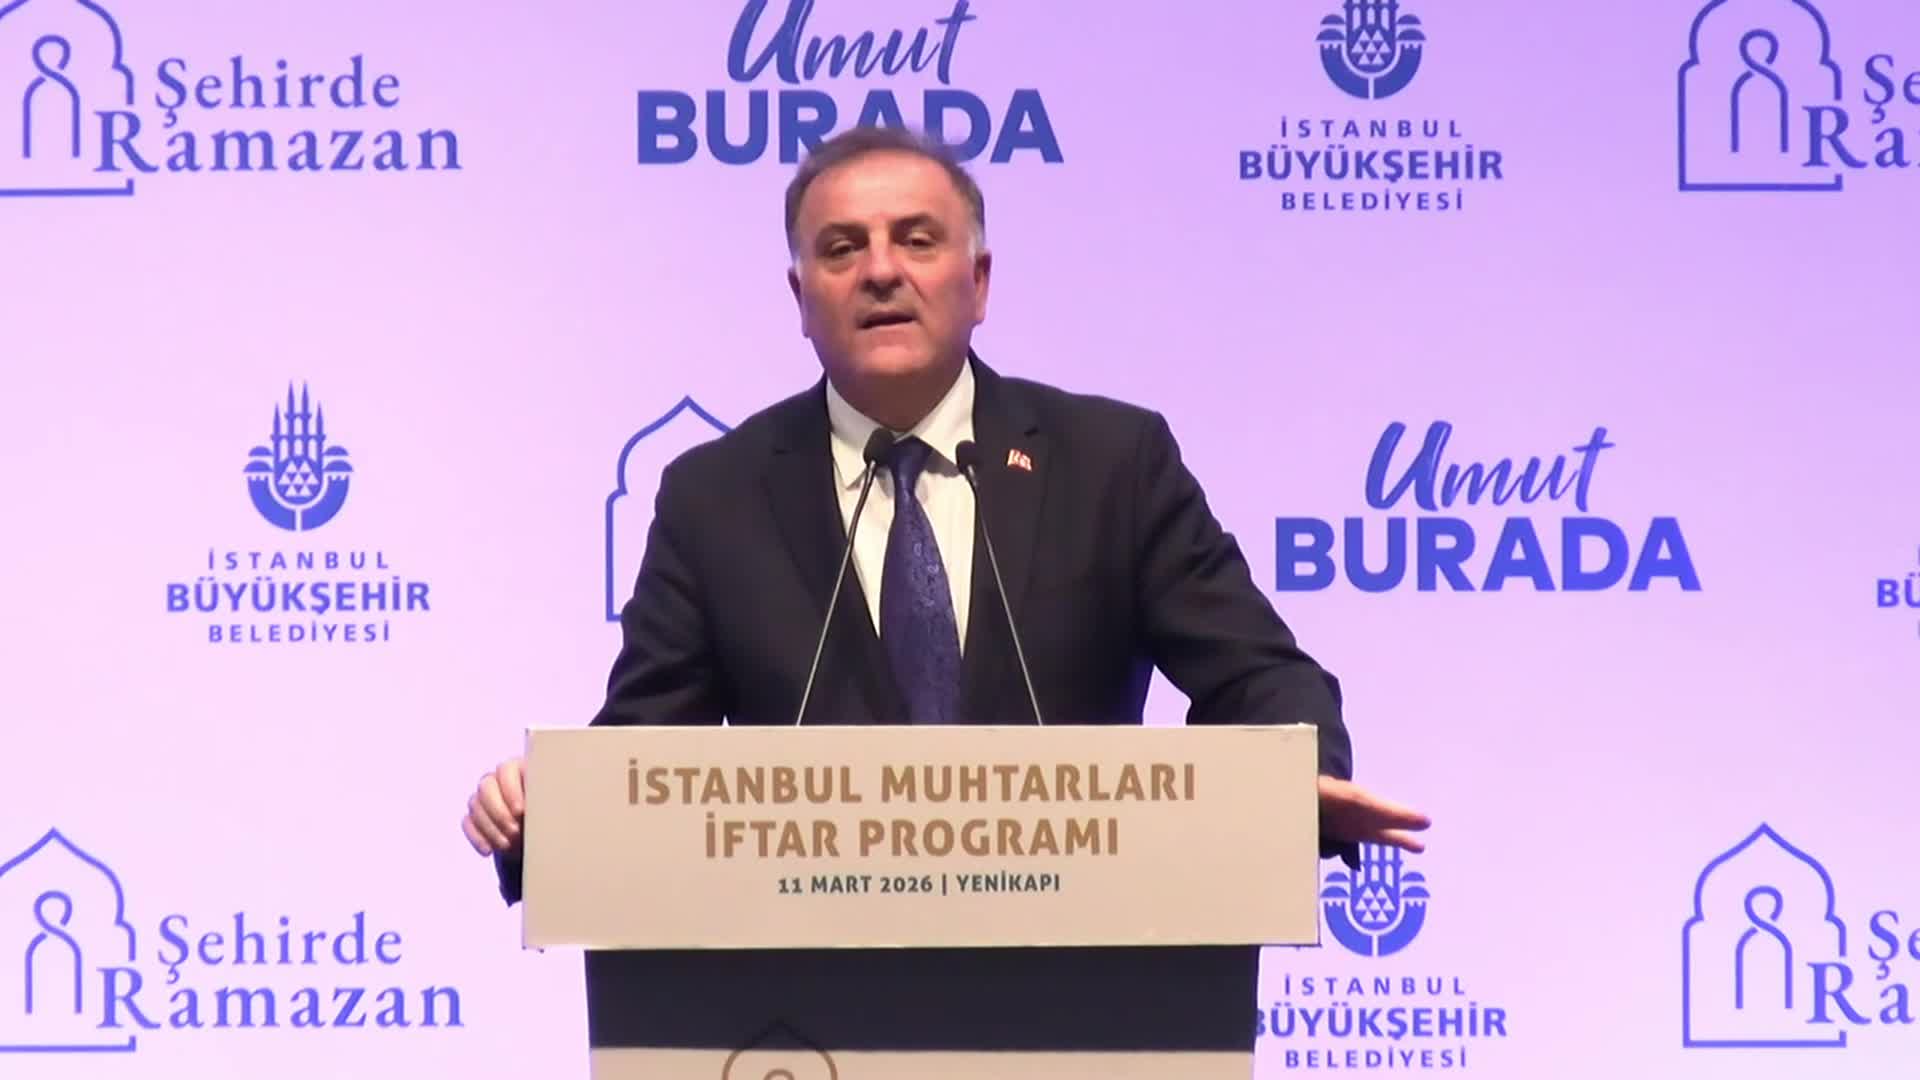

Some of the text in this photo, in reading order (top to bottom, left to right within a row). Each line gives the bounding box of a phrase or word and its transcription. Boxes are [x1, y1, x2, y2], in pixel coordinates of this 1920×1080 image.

[727, 0, 976, 85] Umut
[156, 54, 399, 125] Şehirde
[94, 109, 462, 173] Ramazan
[1281, 116, 1462, 138] İSTANBUL
[1239, 145, 1503, 183] BÜYÜKŞEHİR
[1281, 188, 1462, 211] BELEDİYESİ
[1365, 421, 1614, 512] Umut
[208, 548, 389, 570] İSTANBUL
[1275, 516, 1702, 592] BURADA
[166, 576, 431, 614] BÜYÜKŞEHİR
[208, 620, 390, 643] BELEDİYESİ
[628, 758, 1195, 805] İSTANBUL MUHTARLARI
[705, 812, 1119, 858] İFTAR PROGRAMI
[778, 877, 803, 894] 11
[811, 875, 872, 894] MART
[880, 874, 933, 894] 2026
[956, 870, 1060, 893] YENİKAPI
[158, 911, 402, 983] Şehirde
[96, 966, 464, 1029] Ramazan
[1284, 973, 1465, 996] İSTANBUL
[1285, 1046, 1466, 1069] BELEDİYESİ
